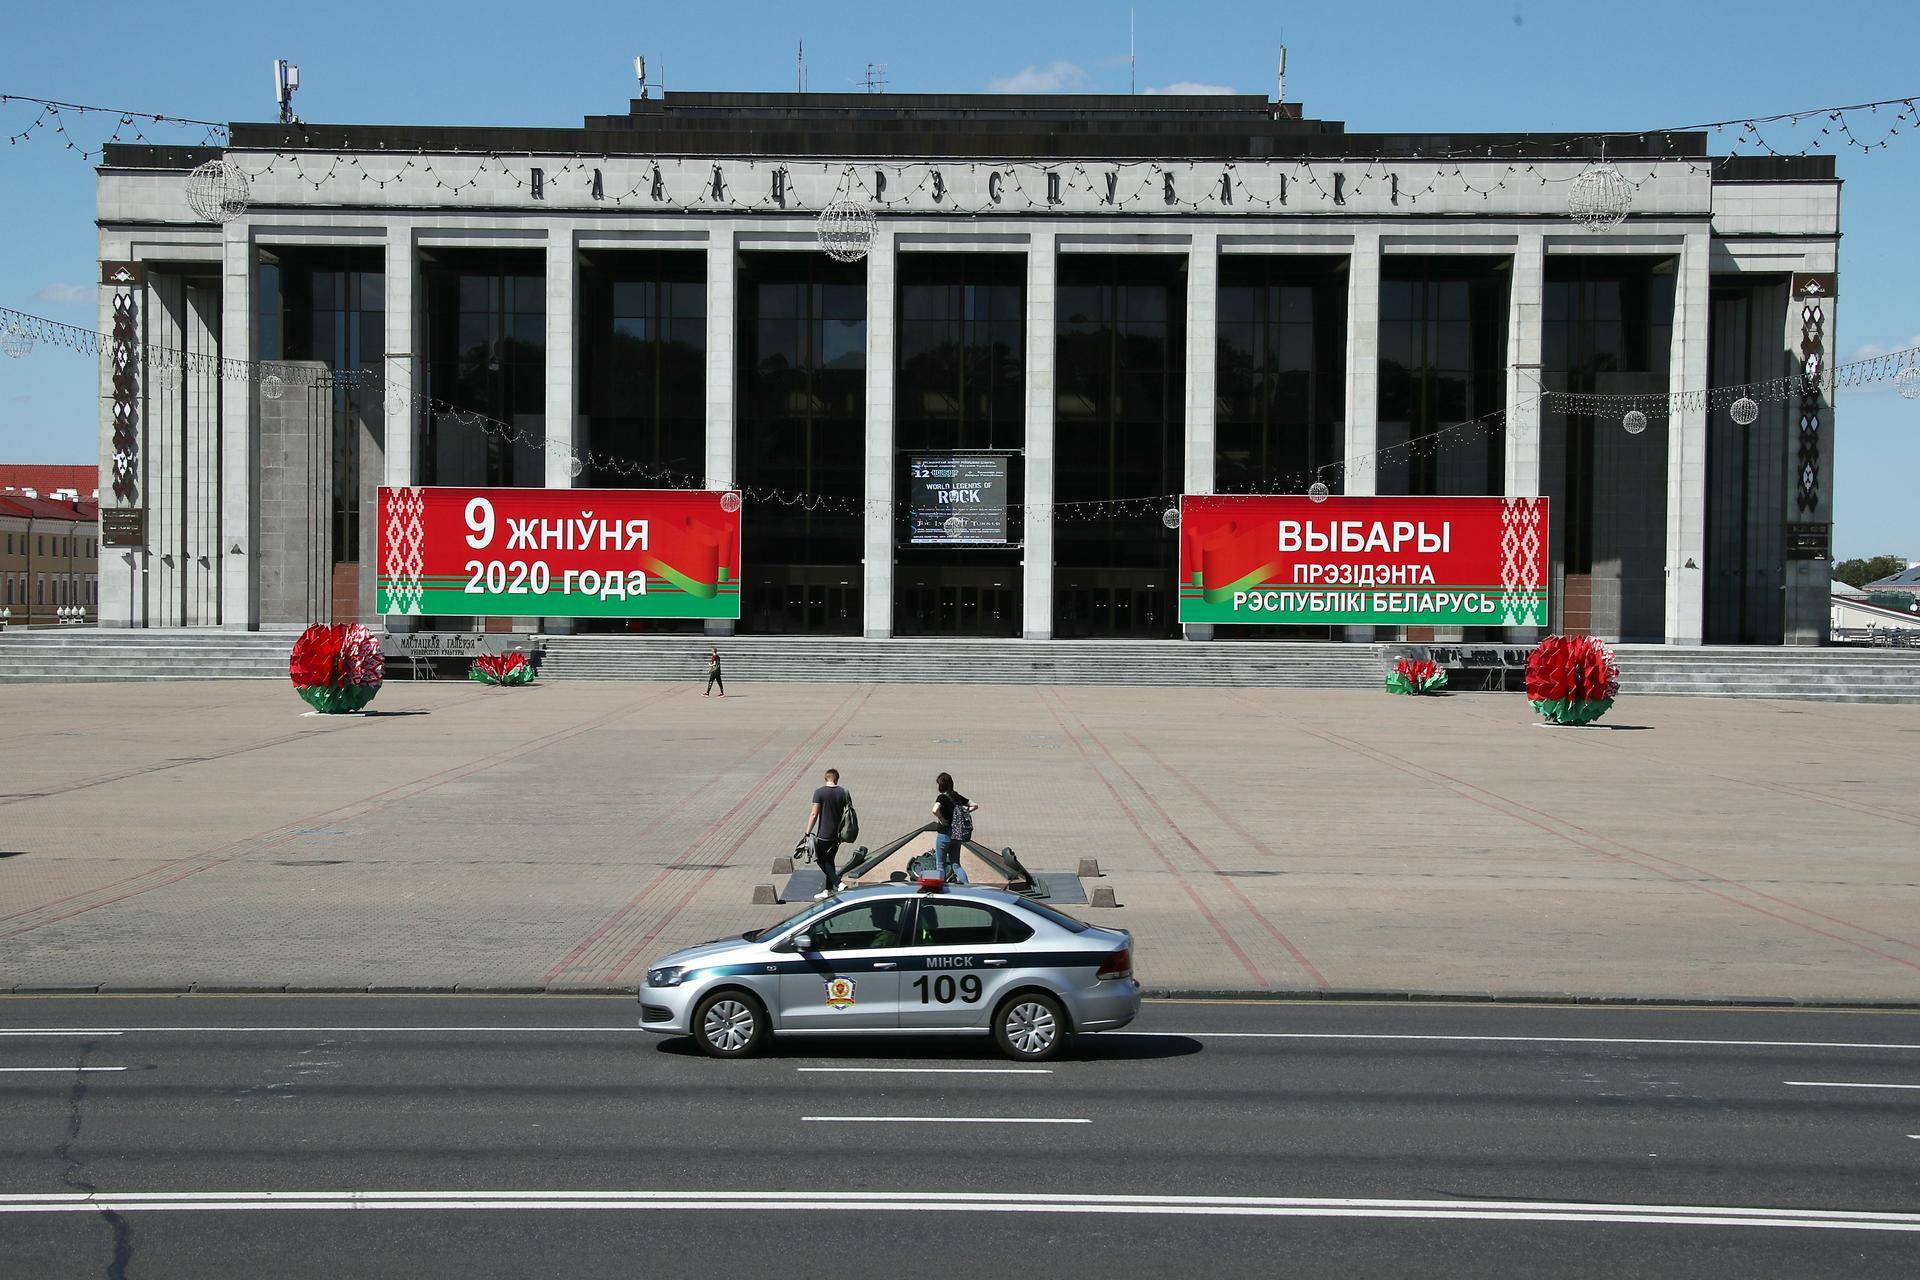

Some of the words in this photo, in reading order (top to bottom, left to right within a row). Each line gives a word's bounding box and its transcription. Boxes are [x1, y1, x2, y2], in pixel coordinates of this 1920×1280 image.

[530, 167, 786, 209] ПАЛАЦ
[875, 169, 1399, 206] РЭСПУБЛІКІ
[915, 469, 930, 478] 12
[938, 489, 981, 504] ROCK
[464, 497, 496, 550] 9
[506, 510, 649, 551] ЖНІЎНЯ
[1278, 520, 1450, 553] ВЫБАРЫ
[464, 560, 550, 595] 2020
[563, 569, 647, 601] года
[1293, 564, 1436, 588] ПРЭЗІДЭНТА
[1233, 591, 1366, 613] РЭСПУБЛІКІ
[1373, 593, 1496, 614] БЕЛАРУСЬ
[401, 638, 440, 649] МАСТАЦКАЯ
[926, 956, 973, 968] МІНСК
[913, 974, 983, 1004] 109
